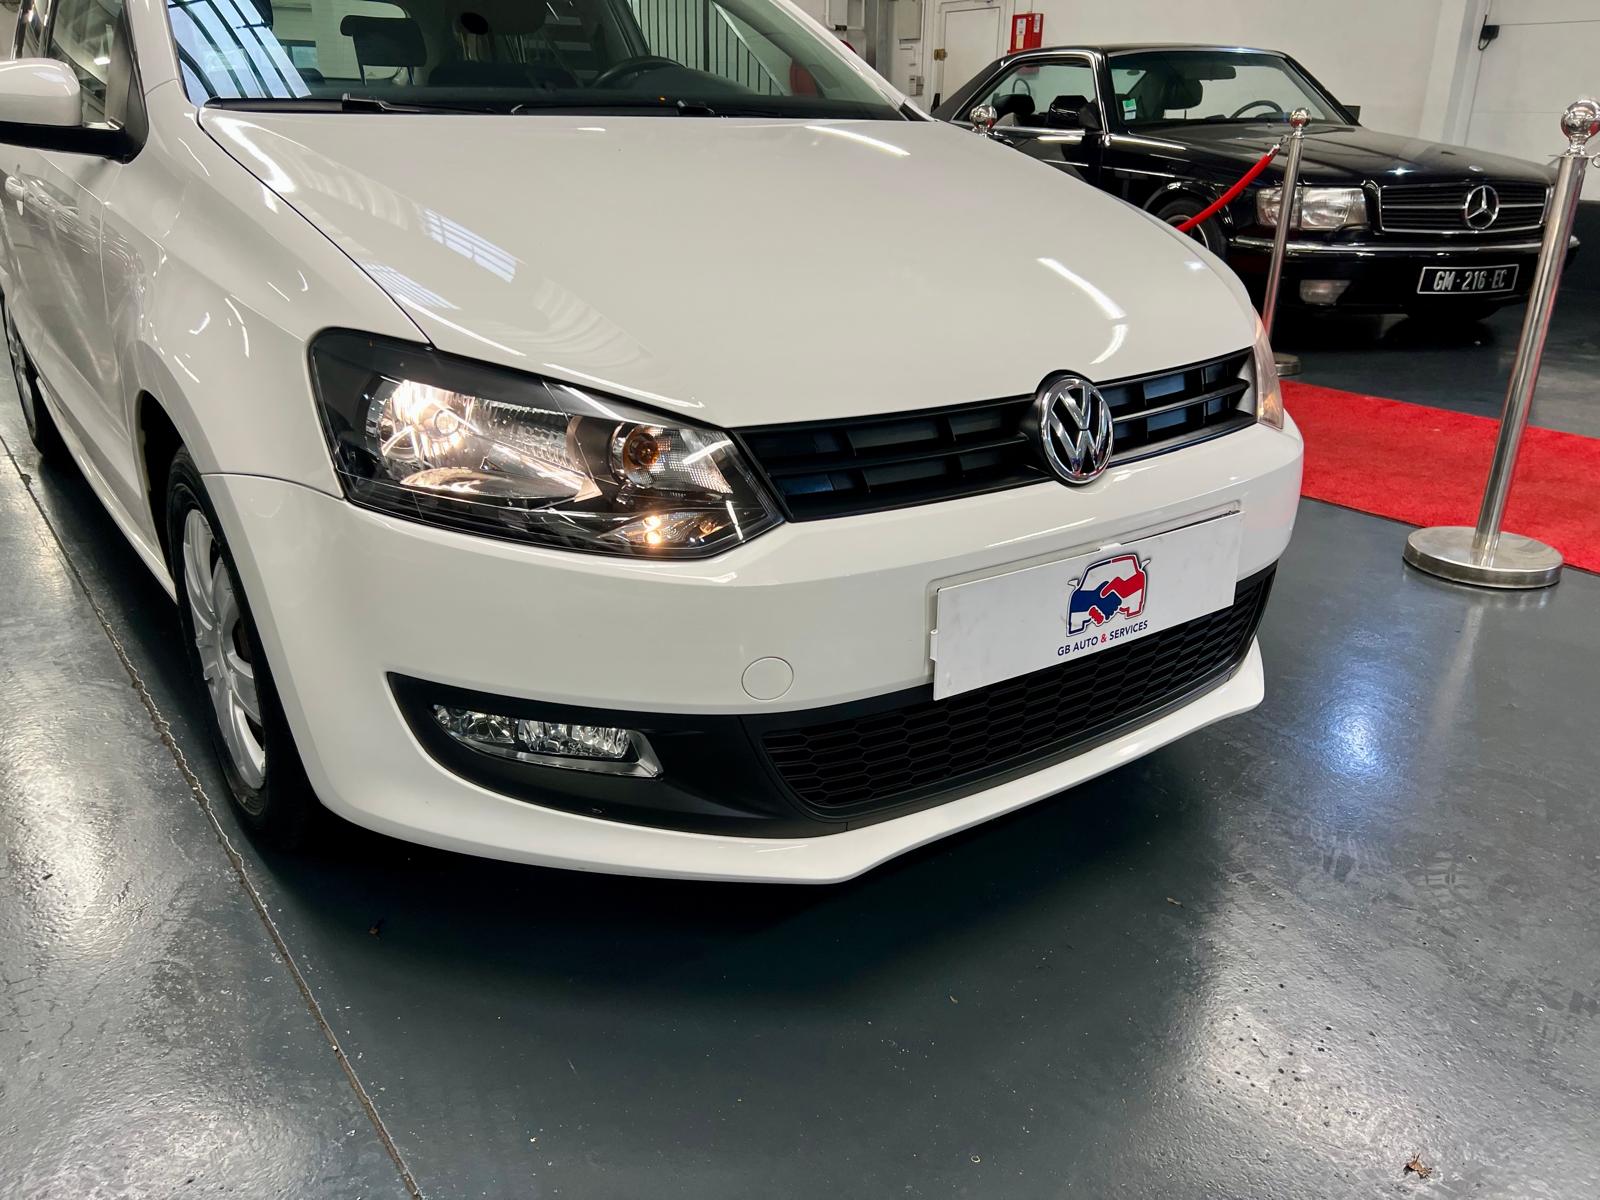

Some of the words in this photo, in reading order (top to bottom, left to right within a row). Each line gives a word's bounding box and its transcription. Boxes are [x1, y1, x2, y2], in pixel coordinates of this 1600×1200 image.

[1057, 644, 1071, 656] GB
[1072, 636, 1098, 653] AUTO
[1100, 633, 1107, 644] &
[1109, 620, 1148, 641] SERVICES
